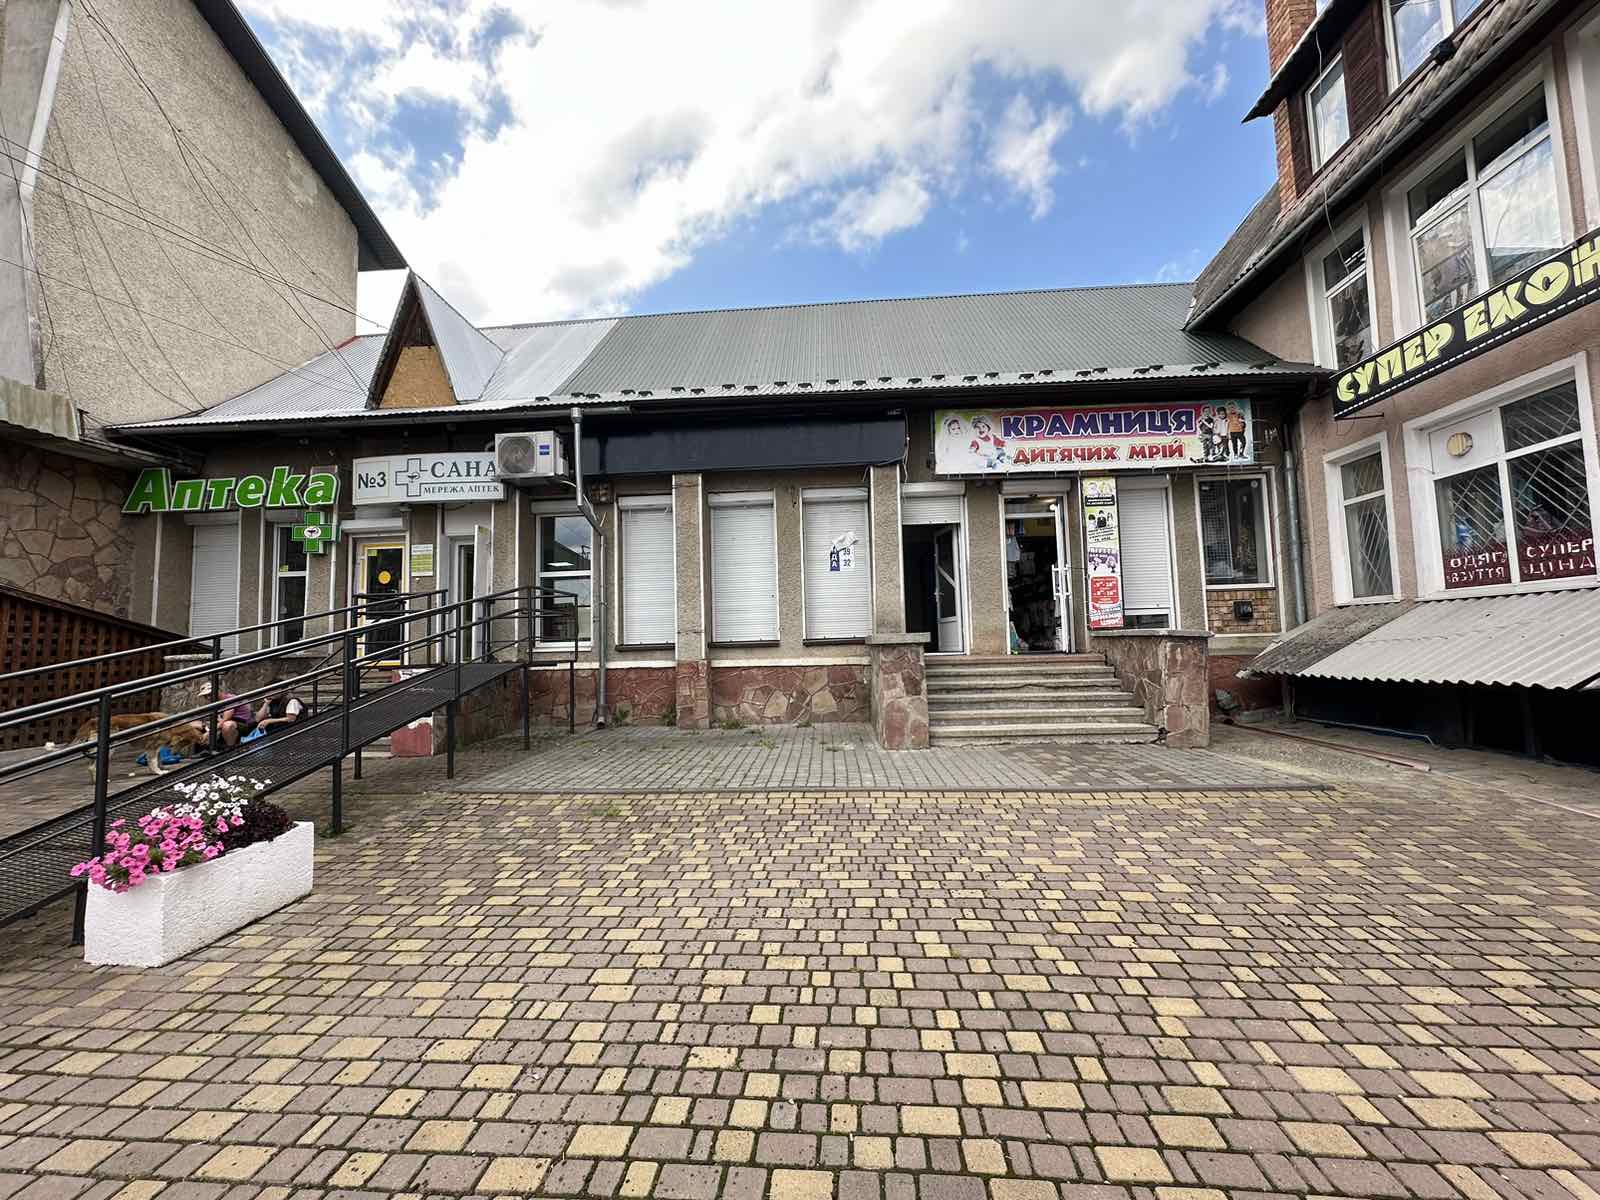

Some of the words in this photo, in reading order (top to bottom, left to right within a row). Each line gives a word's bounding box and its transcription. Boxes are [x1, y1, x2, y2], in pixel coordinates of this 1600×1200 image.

[1336, 322, 1455, 402] СУПЕР
[1000, 408, 1197, 440] КРАМНИЦЯ
[1012, 443, 1118, 465] ДИТЯЧИХ
[1128, 438, 1185, 460] МРІЙ
[122, 465, 339, 513] Аптека
[358, 471, 386, 489] №3
[423, 485, 465, 494] МЕРЕЖА
[467, 485, 500, 494] АПТЕК
[1526, 538, 1593, 558] СУПЕР
[1529, 555, 1594, 577] ЦІНА
